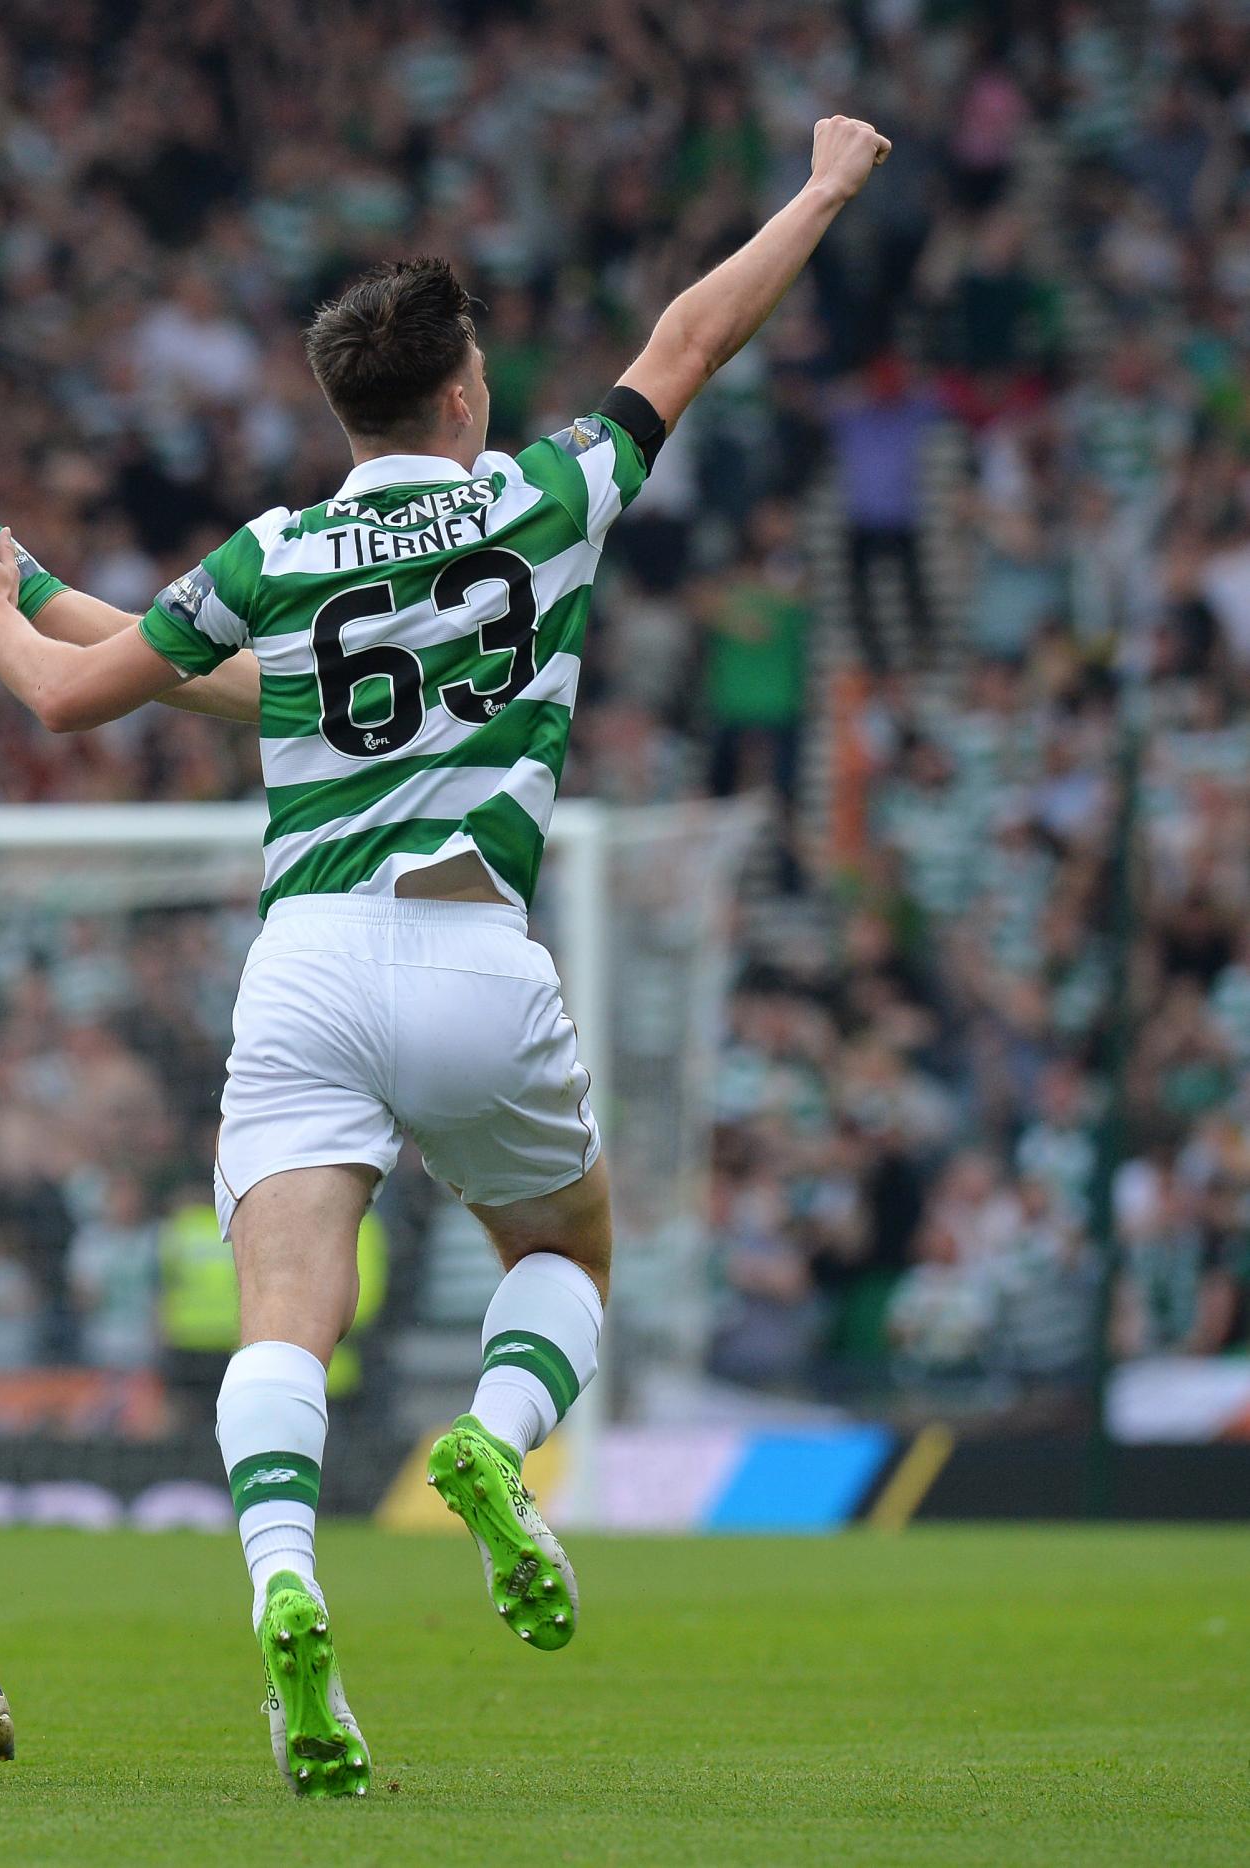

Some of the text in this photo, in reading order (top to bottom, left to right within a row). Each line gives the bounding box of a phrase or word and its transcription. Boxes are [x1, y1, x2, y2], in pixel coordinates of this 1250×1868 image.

[326, 480, 495, 528] MAGNERS
[326, 504, 488, 569] TIERNEY
[310, 546, 539, 760] 63
